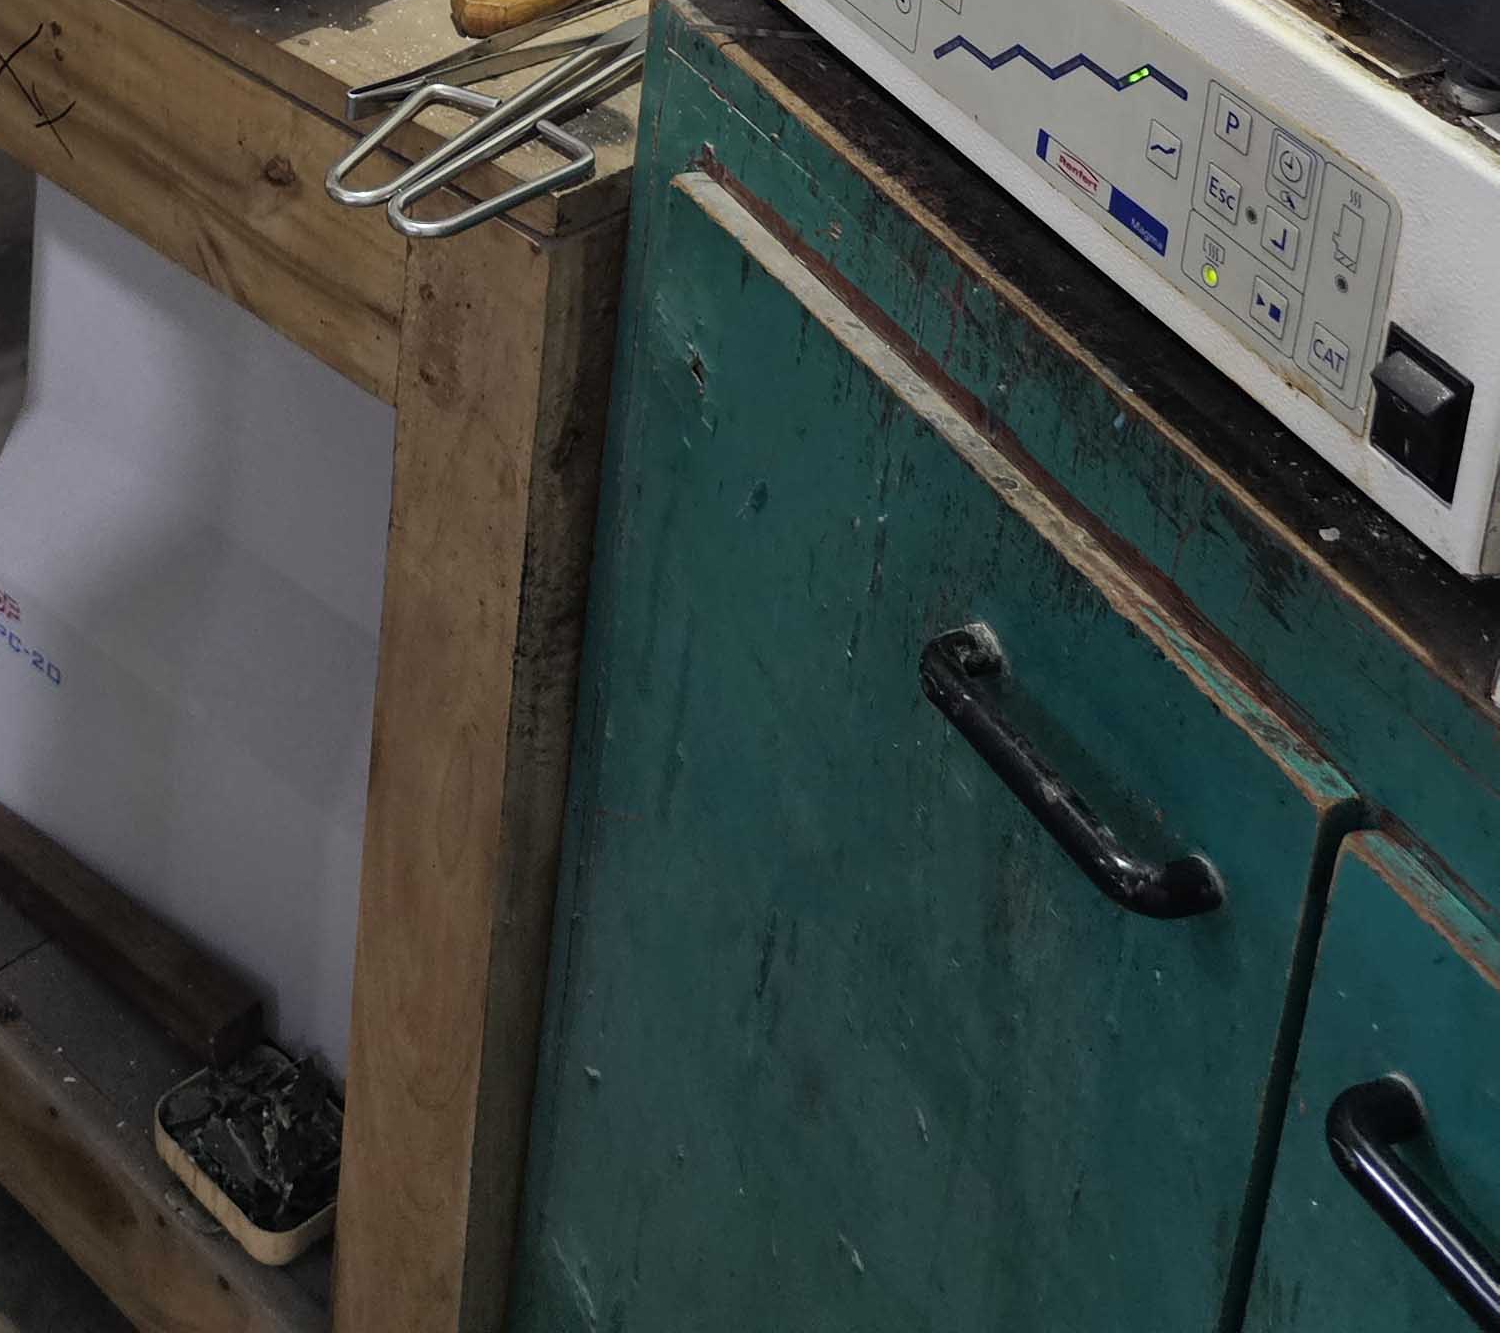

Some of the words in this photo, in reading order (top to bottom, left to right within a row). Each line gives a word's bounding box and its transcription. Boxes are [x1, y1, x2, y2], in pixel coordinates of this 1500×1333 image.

[1225, 111, 1240, 135] P
[1059, 154, 1098, 192] Renfert
[1312, 338, 1345, 373] CAT
